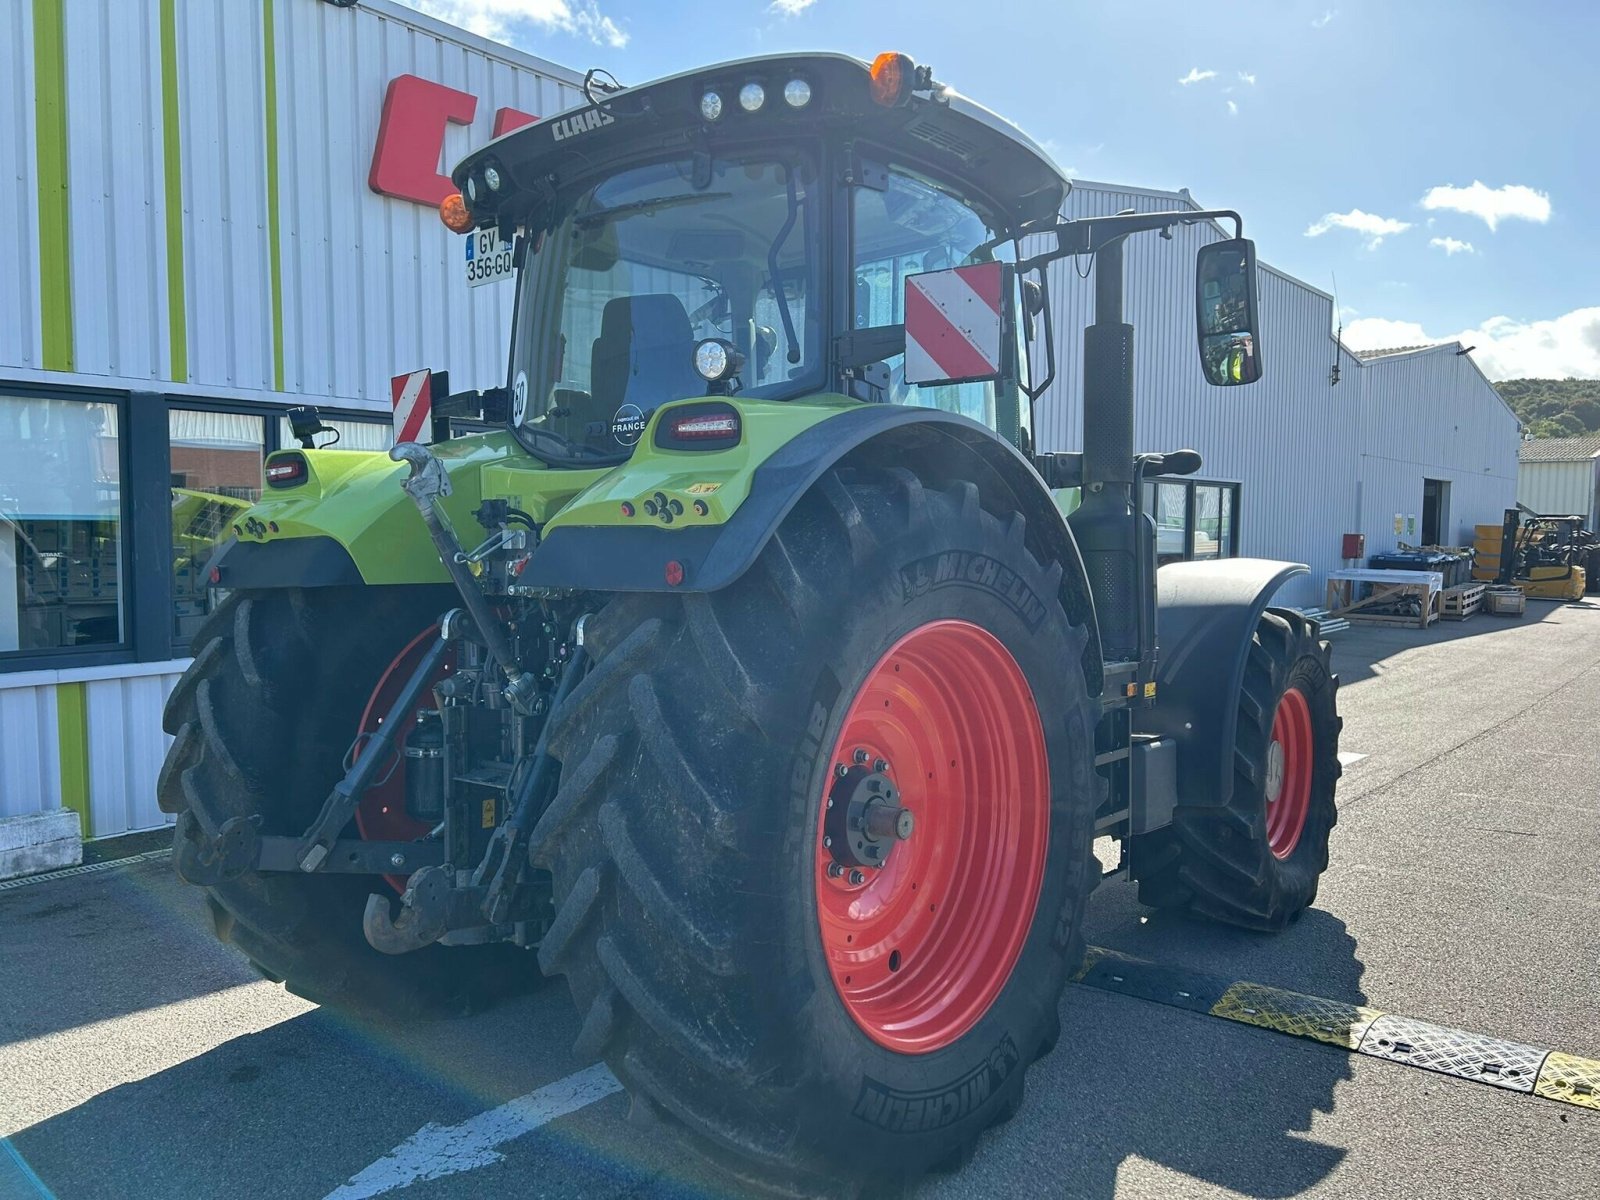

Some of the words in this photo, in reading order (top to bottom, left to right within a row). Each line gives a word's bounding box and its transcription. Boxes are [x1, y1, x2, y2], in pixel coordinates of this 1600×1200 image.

[551, 104, 615, 141] CLAAS
[480, 231, 495, 254] GV
[468, 252, 511, 281] 356-GQ
[515, 381, 525, 417] 50
[612, 421, 645, 433] FRANCE
[933, 552, 1045, 626] MICHELIN
[853, 1065, 990, 1133] MICHELIN
